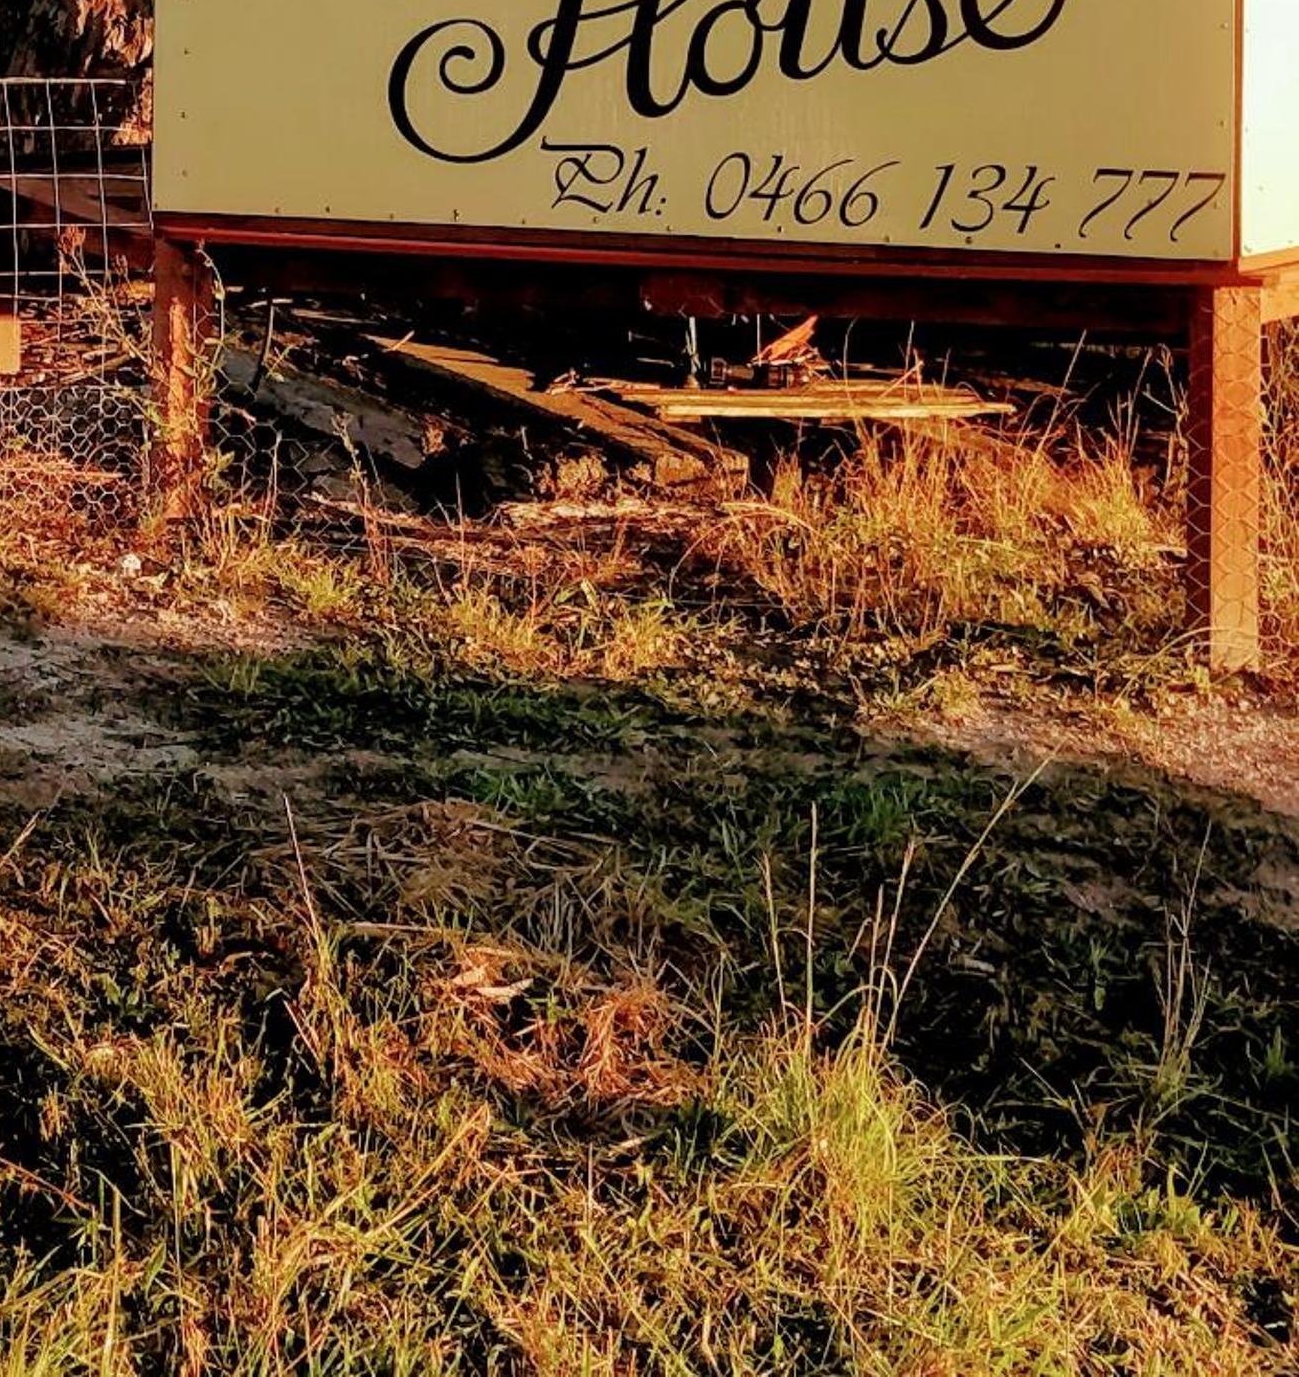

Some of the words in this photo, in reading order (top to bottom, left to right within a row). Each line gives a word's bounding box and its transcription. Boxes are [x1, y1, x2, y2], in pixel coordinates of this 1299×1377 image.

[541, 136, 669, 217] Ph:
[705, 151, 901, 228] 0466
[918, 163, 1056, 234] 134
[1079, 168, 1227, 243] 777
